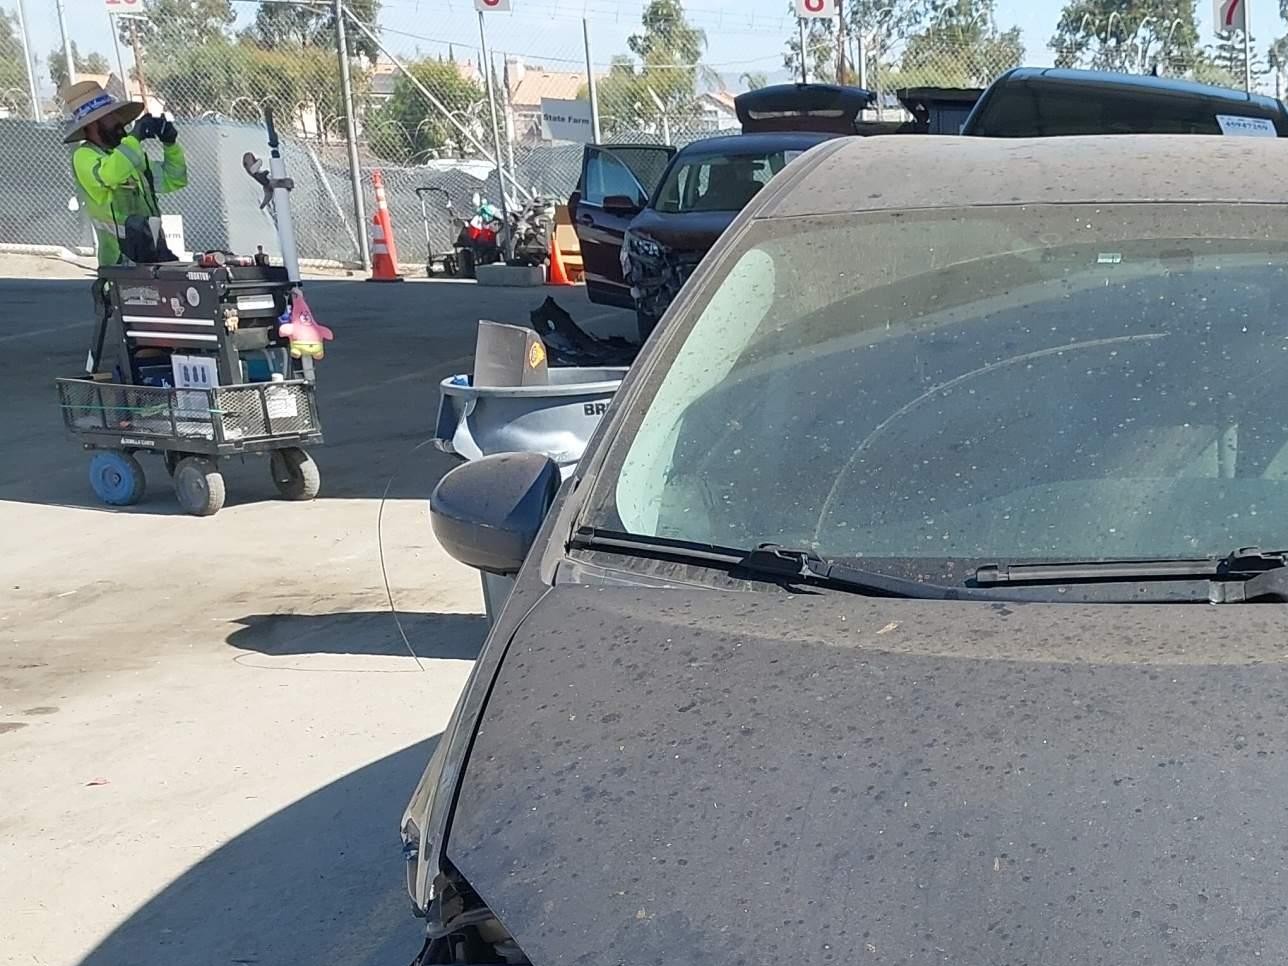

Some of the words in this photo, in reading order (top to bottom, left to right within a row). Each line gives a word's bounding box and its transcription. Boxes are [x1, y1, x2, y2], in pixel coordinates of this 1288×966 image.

[543, 113, 566, 122] State
[567, 115, 590, 124] Farm
[583, 402, 612, 417] BR
